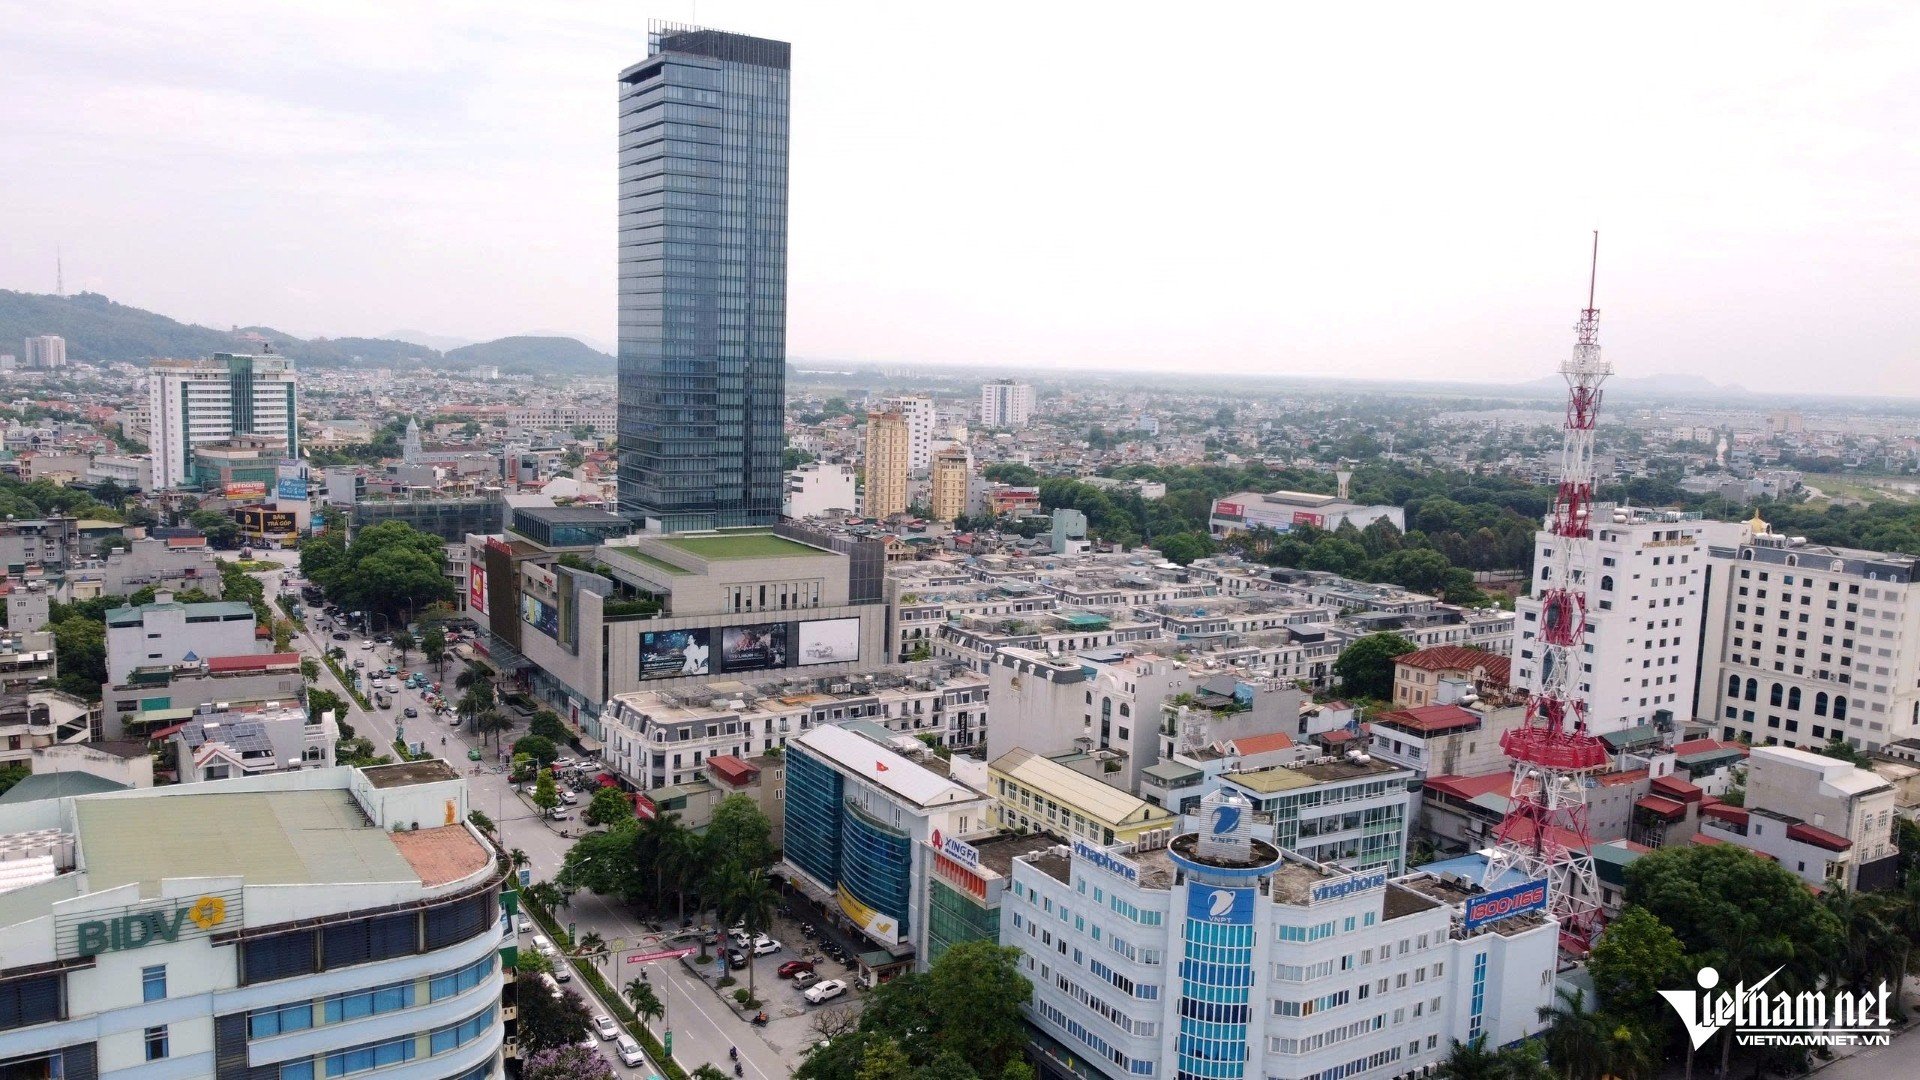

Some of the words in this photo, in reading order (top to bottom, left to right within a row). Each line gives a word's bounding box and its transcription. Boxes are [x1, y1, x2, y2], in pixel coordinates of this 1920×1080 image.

[945, 837, 977, 863] XINGFA
[1210, 836, 1239, 845] VNPT
[1073, 841, 1136, 881] vinaphone
[1312, 873, 1386, 901] vinaphone
[78, 907, 190, 956] BIDV
[1208, 915, 1232, 923] VNPT
